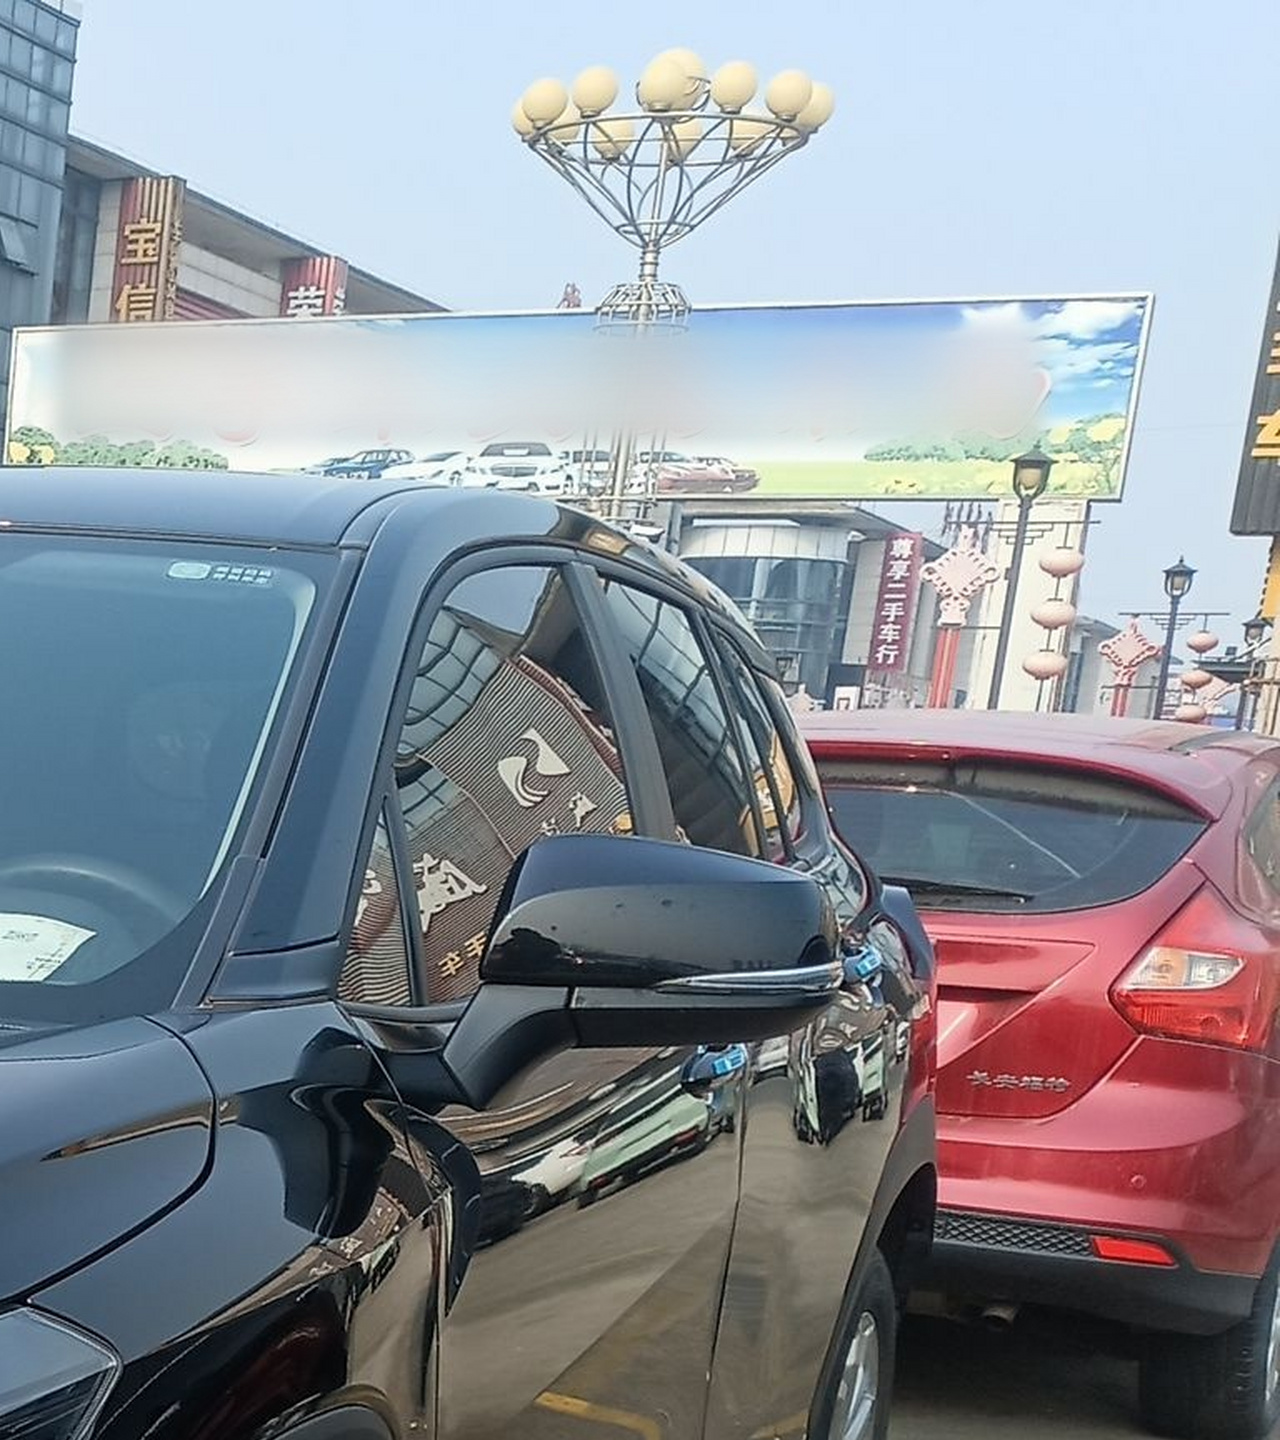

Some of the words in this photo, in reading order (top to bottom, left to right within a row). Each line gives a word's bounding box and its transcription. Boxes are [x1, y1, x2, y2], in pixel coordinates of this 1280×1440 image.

[876, 538, 915, 664] 尊享二手车行
